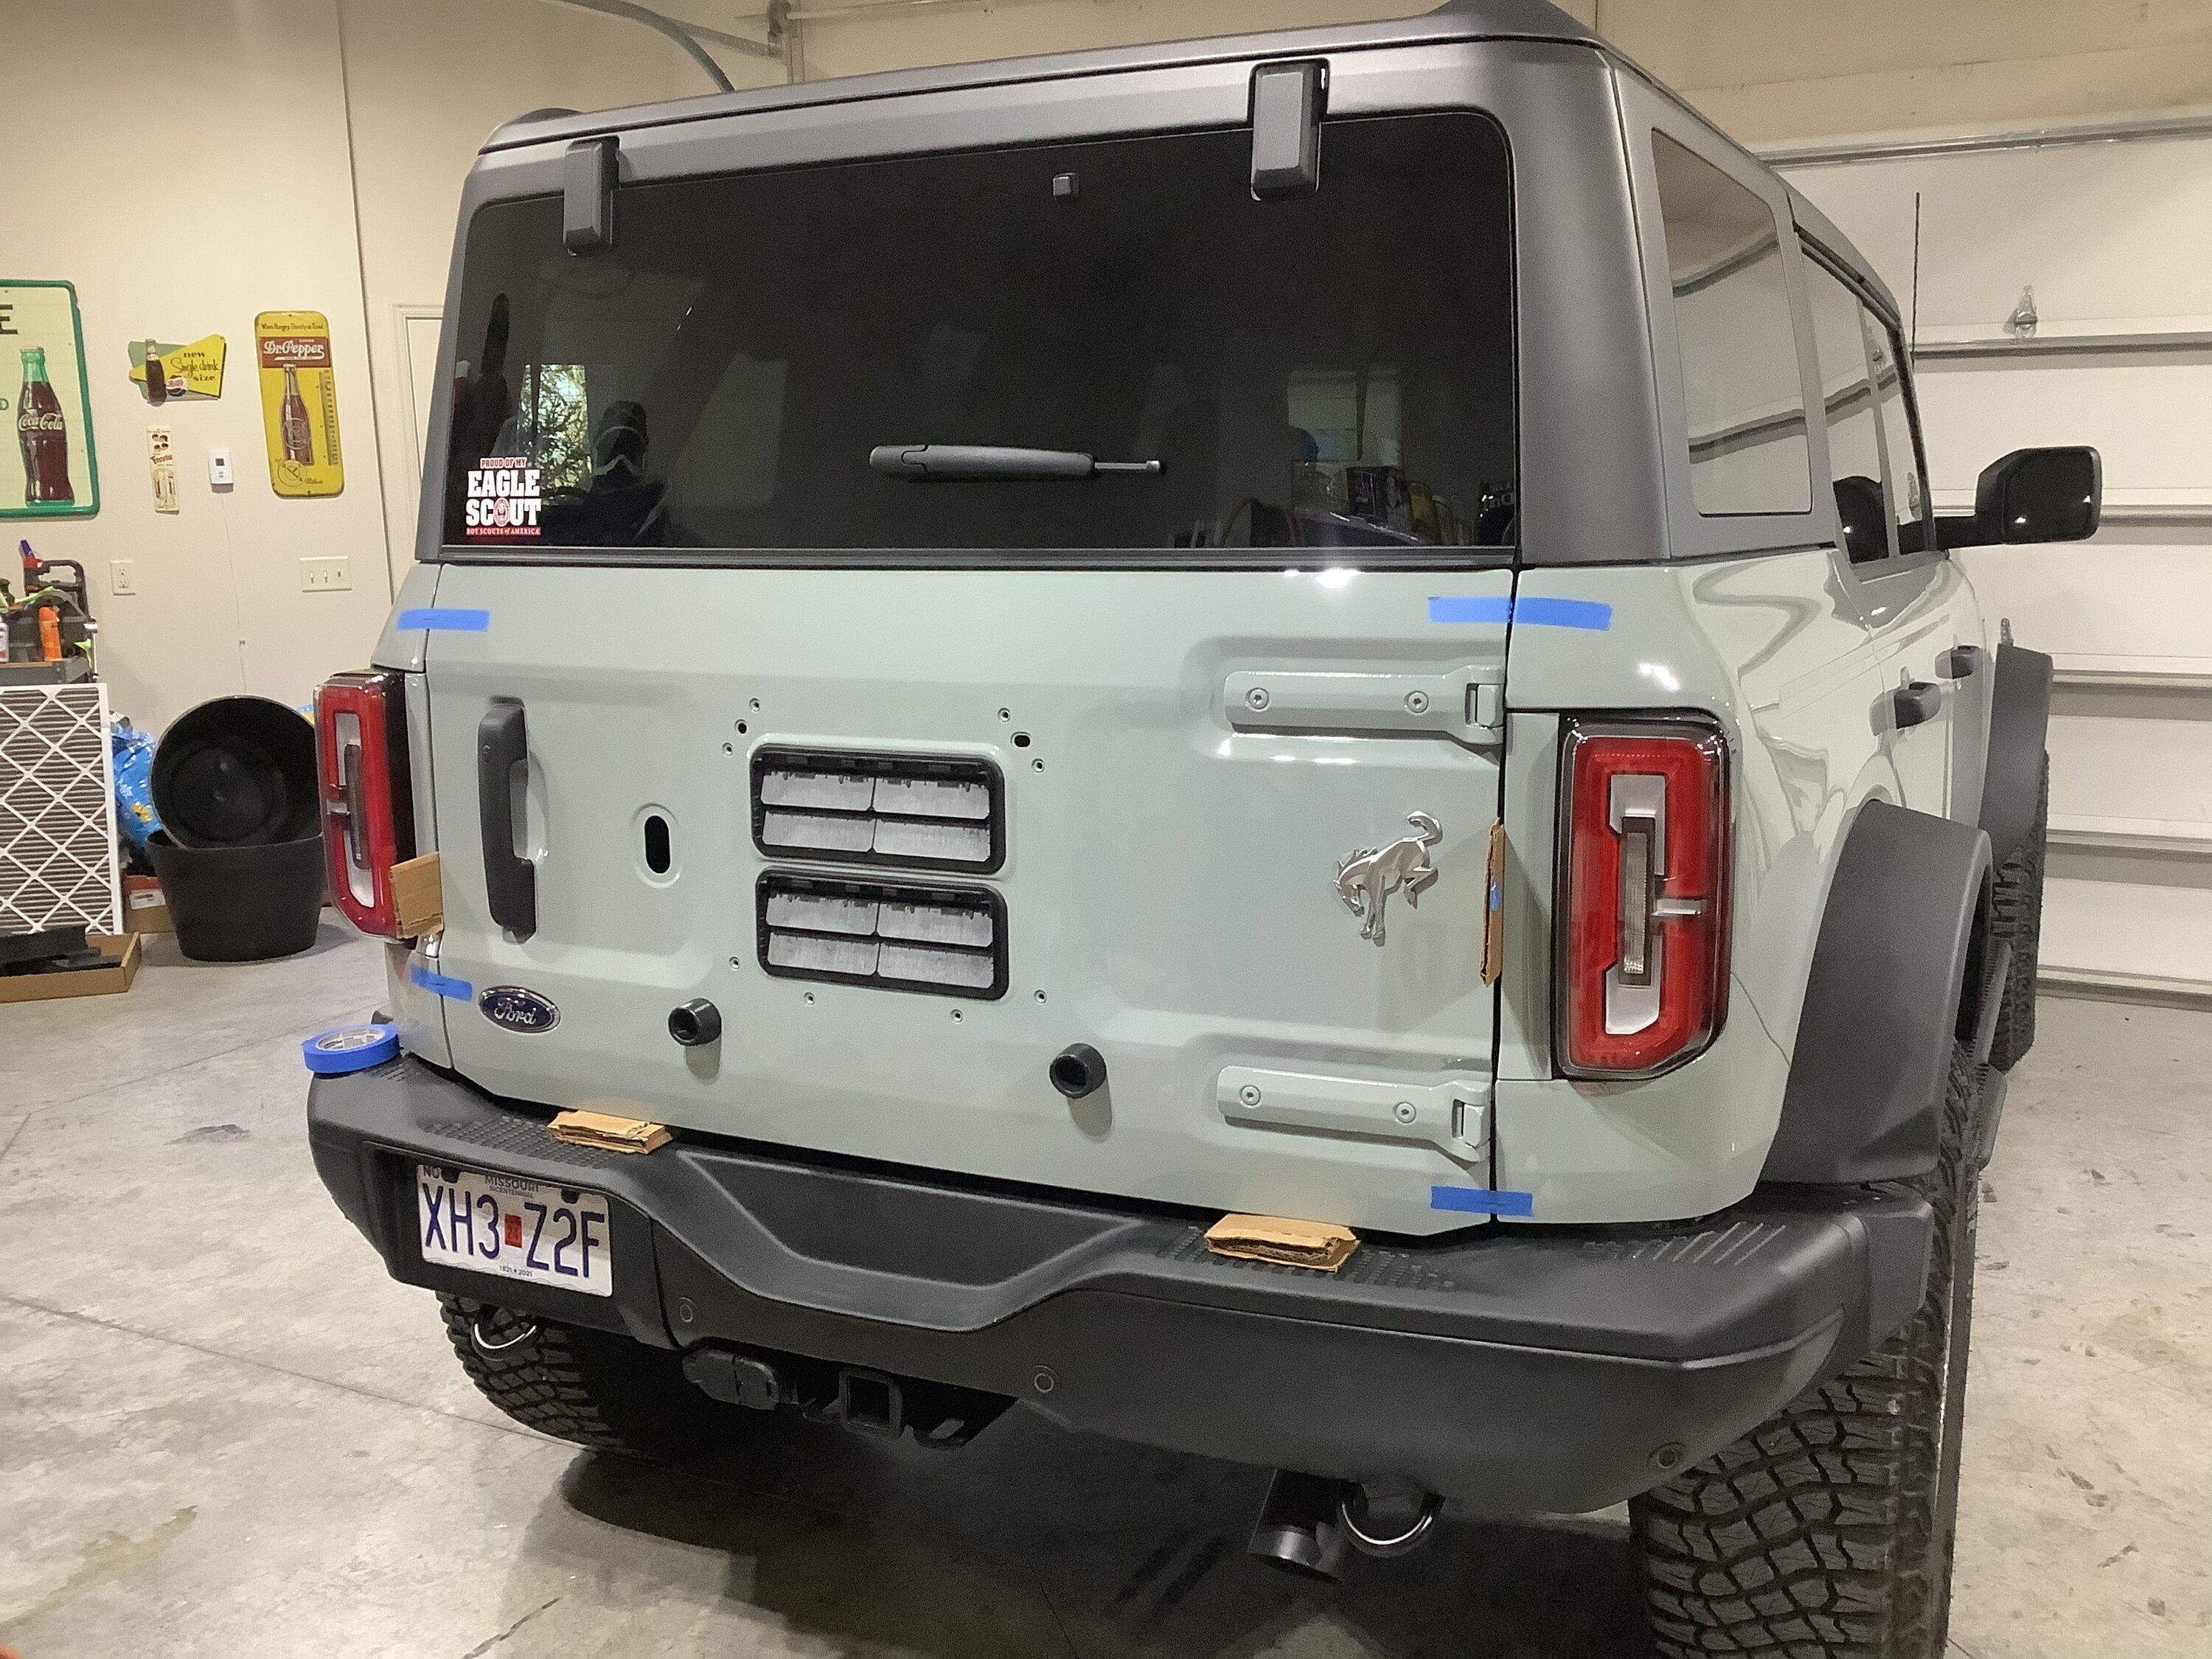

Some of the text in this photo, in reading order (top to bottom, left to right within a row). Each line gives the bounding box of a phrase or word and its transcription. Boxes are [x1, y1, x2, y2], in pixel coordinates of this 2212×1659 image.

[170, 358, 219, 378] Single drink
[481, 458, 526, 467] PROUD OF MY
[467, 470, 540, 497] EAGLE
[466, 498, 541, 526] SCOUT
[467, 527, 479, 535] BOY
[479, 527, 504, 535] SCOUTS
[511, 527, 540, 535] AMERICA
[493, 997, 536, 1024] Ford
[485, 1175, 539, 1192] MISSOURI
[490, 1185, 535, 1198] BICENTENNIAL
[422, 1183, 500, 1259] XH3
[524, 1202, 605, 1279] Z2F
